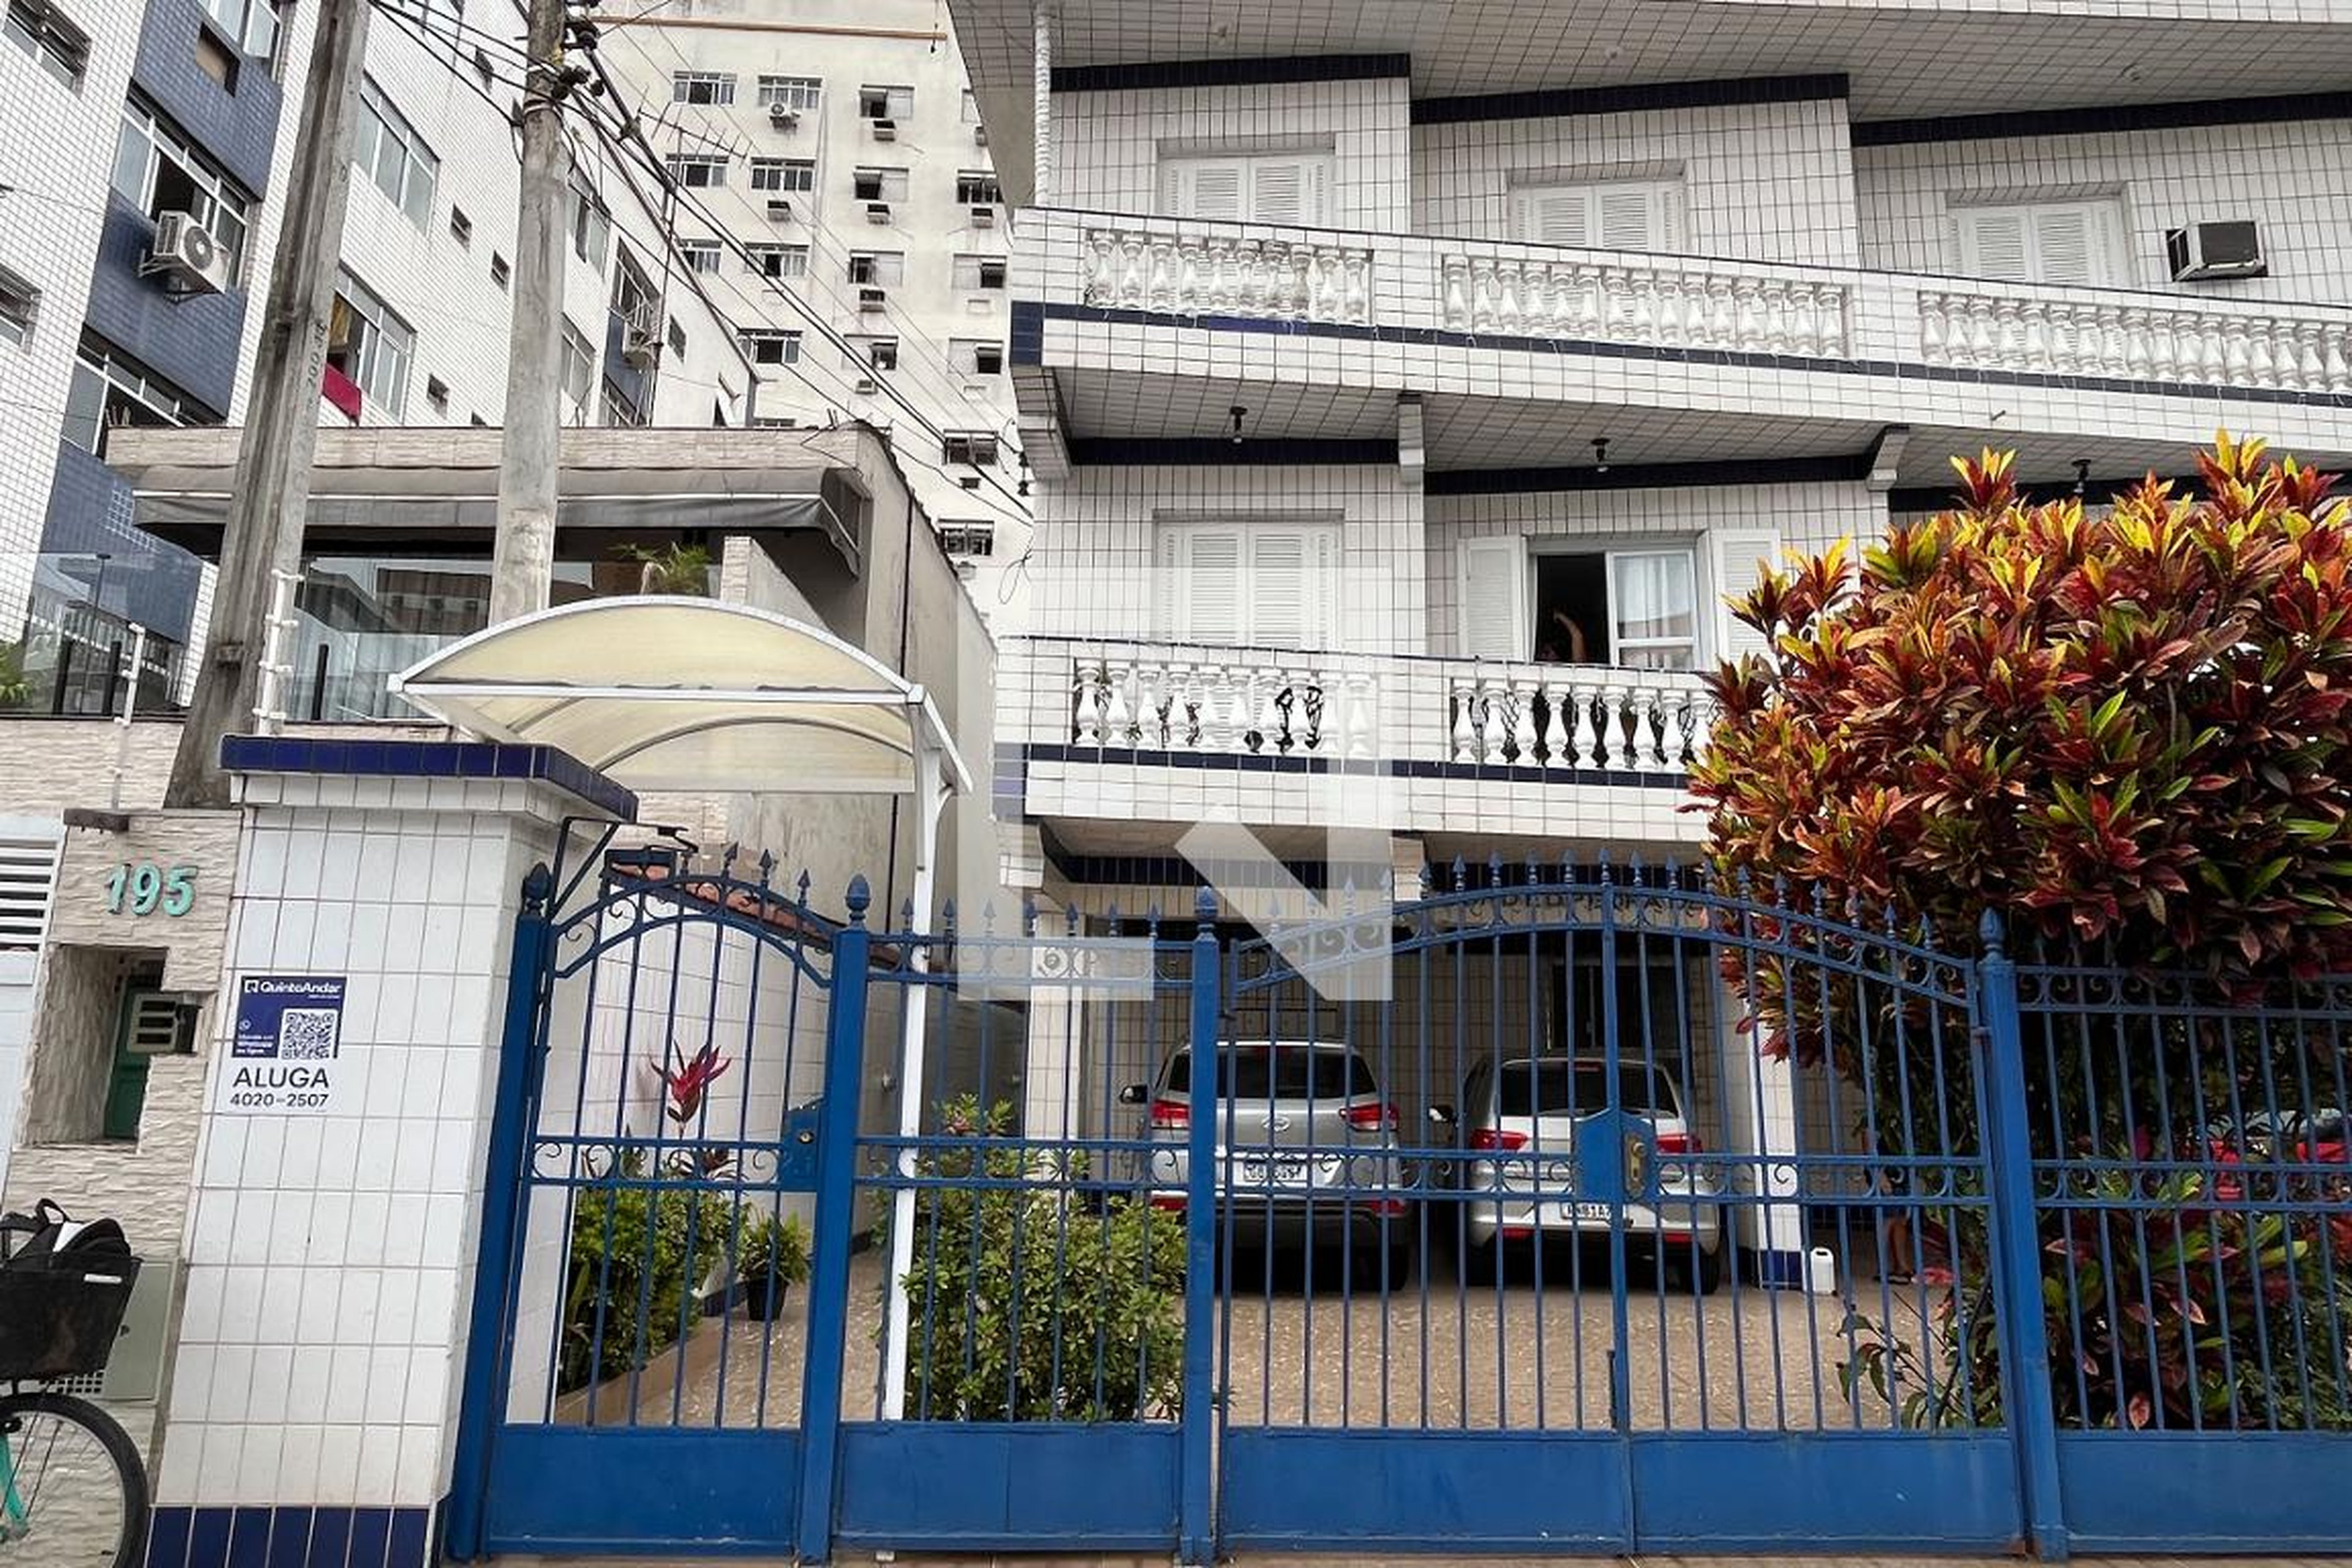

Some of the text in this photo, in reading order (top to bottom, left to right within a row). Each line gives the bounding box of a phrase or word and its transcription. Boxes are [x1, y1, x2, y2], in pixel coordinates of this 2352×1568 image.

[105, 861, 199, 917] 195
[260, 981, 341, 993] QuintoAndar
[233, 1067, 329, 1088] ALUGA
[230, 1093, 329, 1107] 4020-2507
